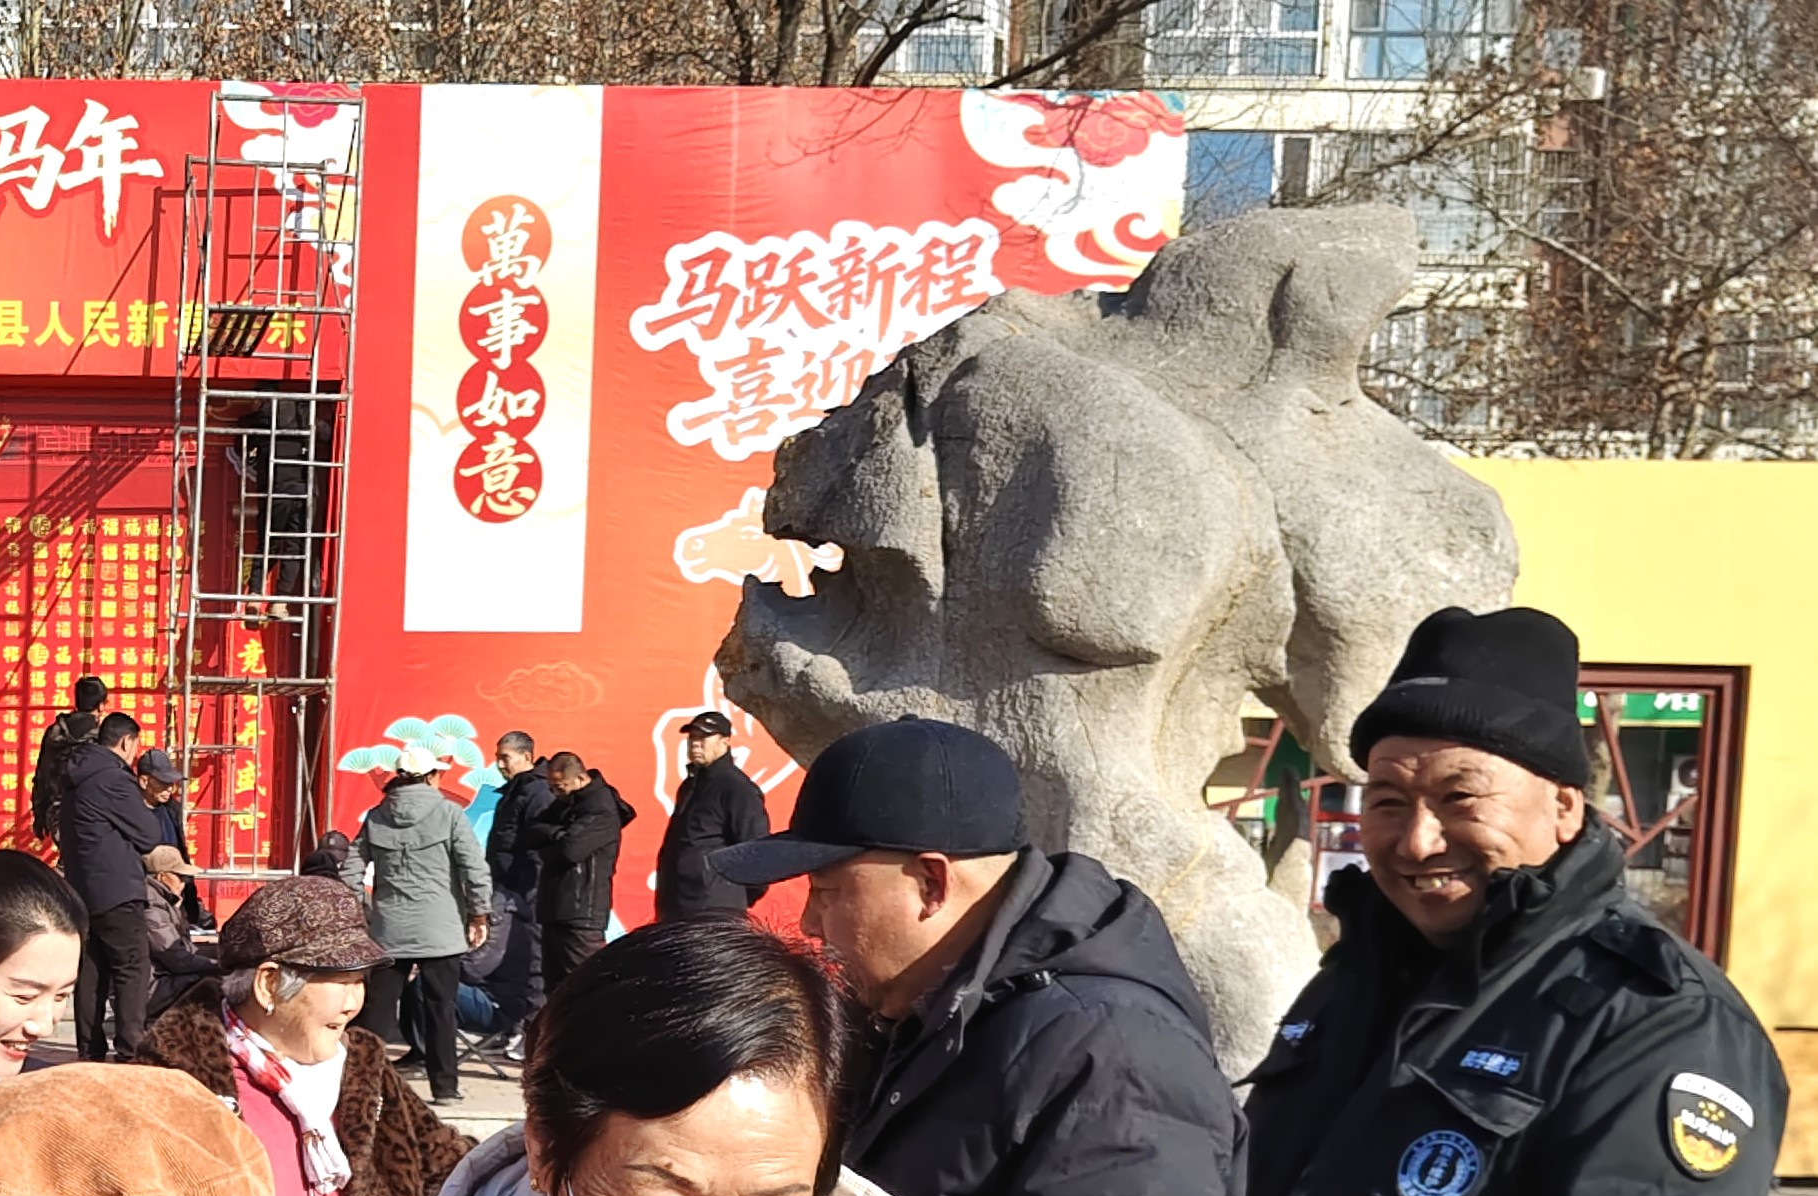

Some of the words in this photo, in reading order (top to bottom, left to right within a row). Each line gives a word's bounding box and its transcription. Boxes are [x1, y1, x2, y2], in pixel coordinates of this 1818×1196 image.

[645, 233, 988, 342] 马跃新程
[460, 203, 542, 515] 萬事如意
[683, 331, 918, 445] 喜迎
